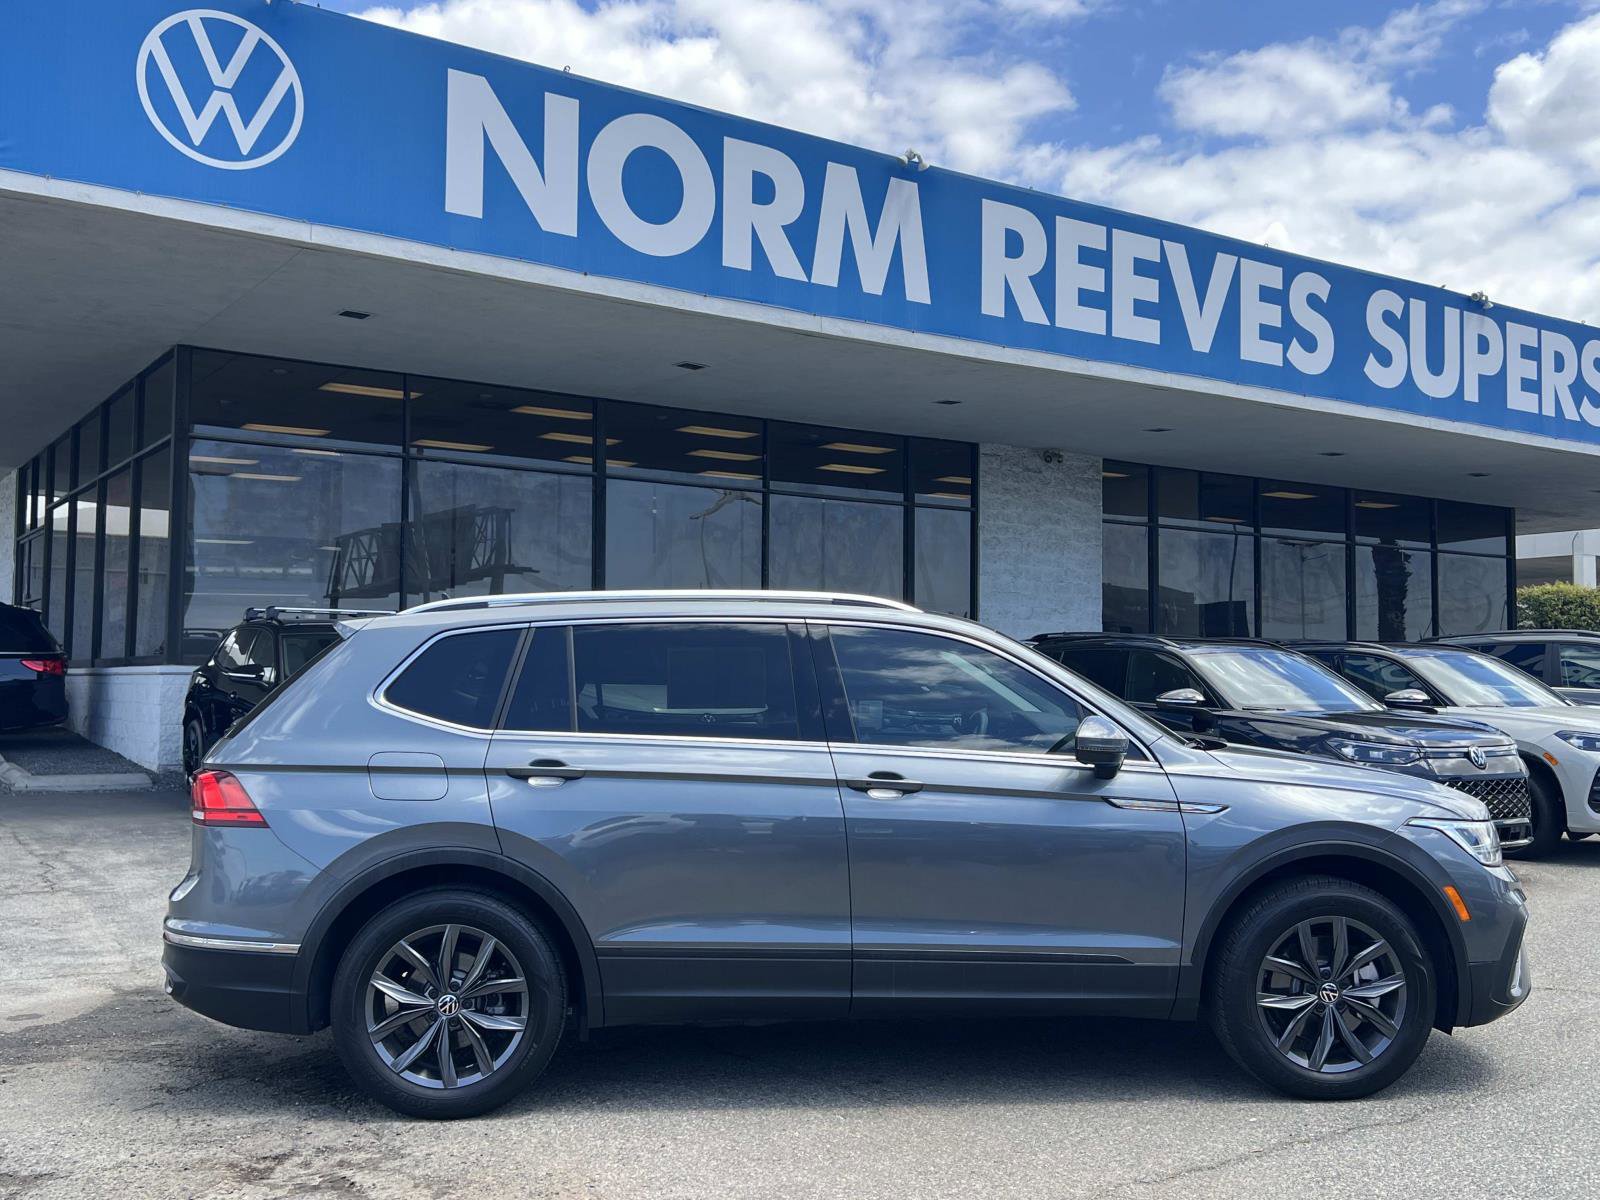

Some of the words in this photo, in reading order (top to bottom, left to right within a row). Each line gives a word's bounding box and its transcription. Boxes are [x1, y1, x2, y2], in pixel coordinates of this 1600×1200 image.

[137, 9, 304, 170] VW
[445, 68, 931, 305] NORM
[981, 198, 1335, 375] REEVES
